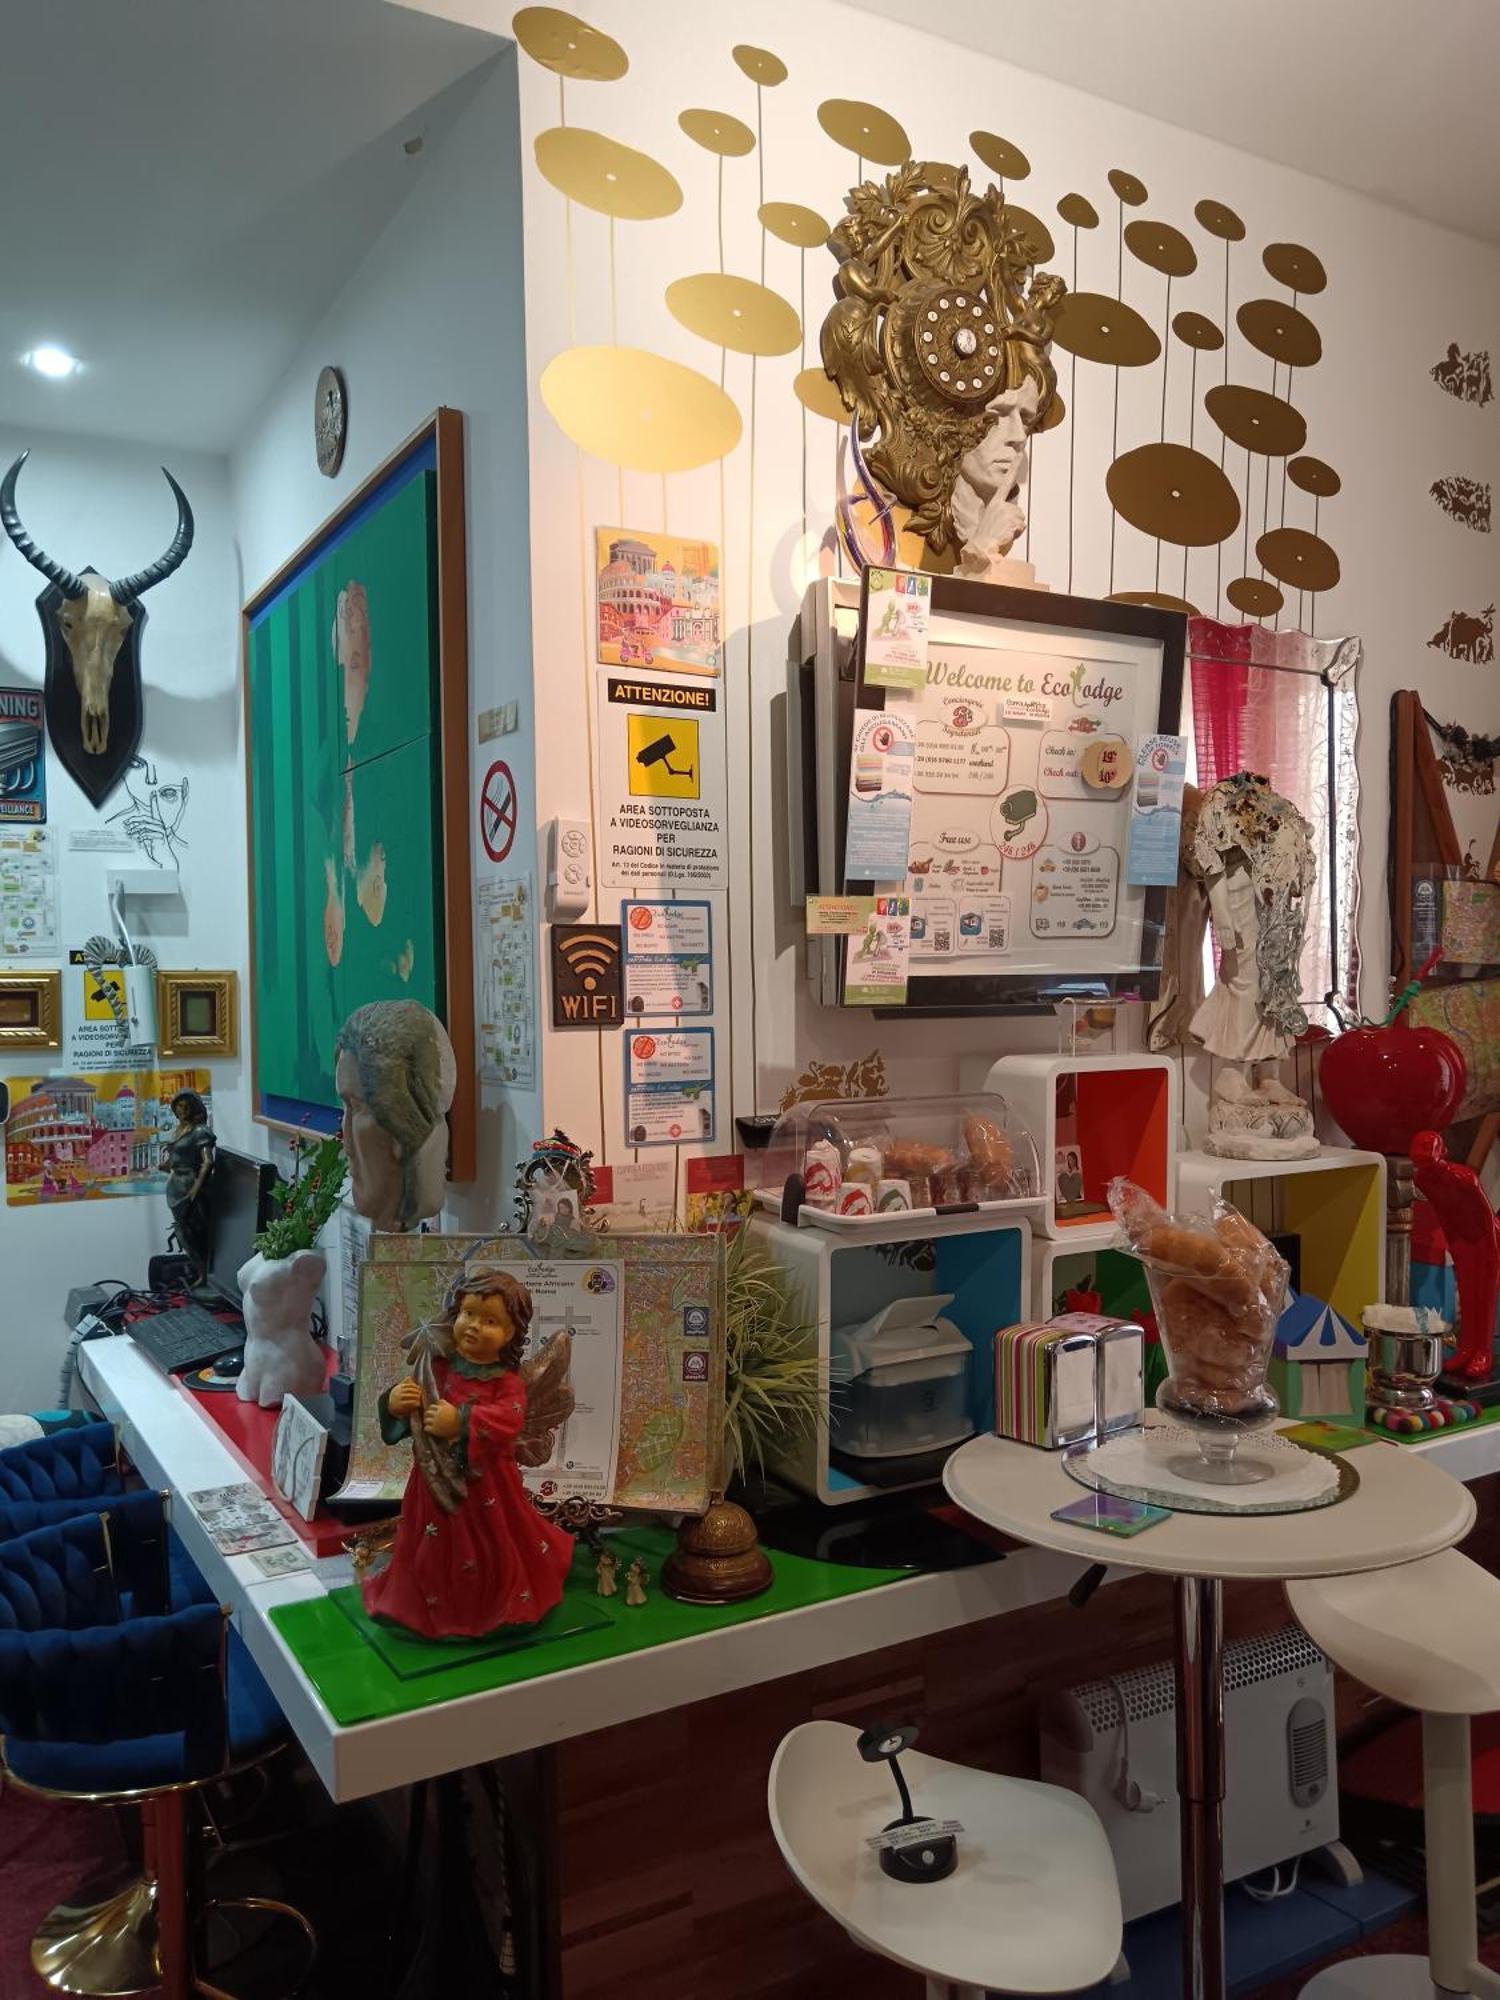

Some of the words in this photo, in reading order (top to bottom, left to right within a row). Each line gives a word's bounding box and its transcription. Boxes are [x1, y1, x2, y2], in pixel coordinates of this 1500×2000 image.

[925, 661, 1013, 693] Welcome
[1017, 673, 1035, 693] to
[615, 684, 709, 706] ATTENZIONE!
[619, 804, 646, 815] AREA
[649, 805, 710, 818] SOTTOPOSTA
[610, 818, 617, 828] A
[620, 818, 719, 832] VIDEOSORVEGLIANZA
[656, 833, 676, 843] PER
[613, 844, 653, 856] RAGIONI
[655, 846, 665, 856] DI
[667, 847, 718, 858] SICUREZZA
[561, 995, 617, 1019] WIFI
[73, 1049, 103, 1057] RAGIONI
[113, 1048, 152, 1057] SICUREZZA
